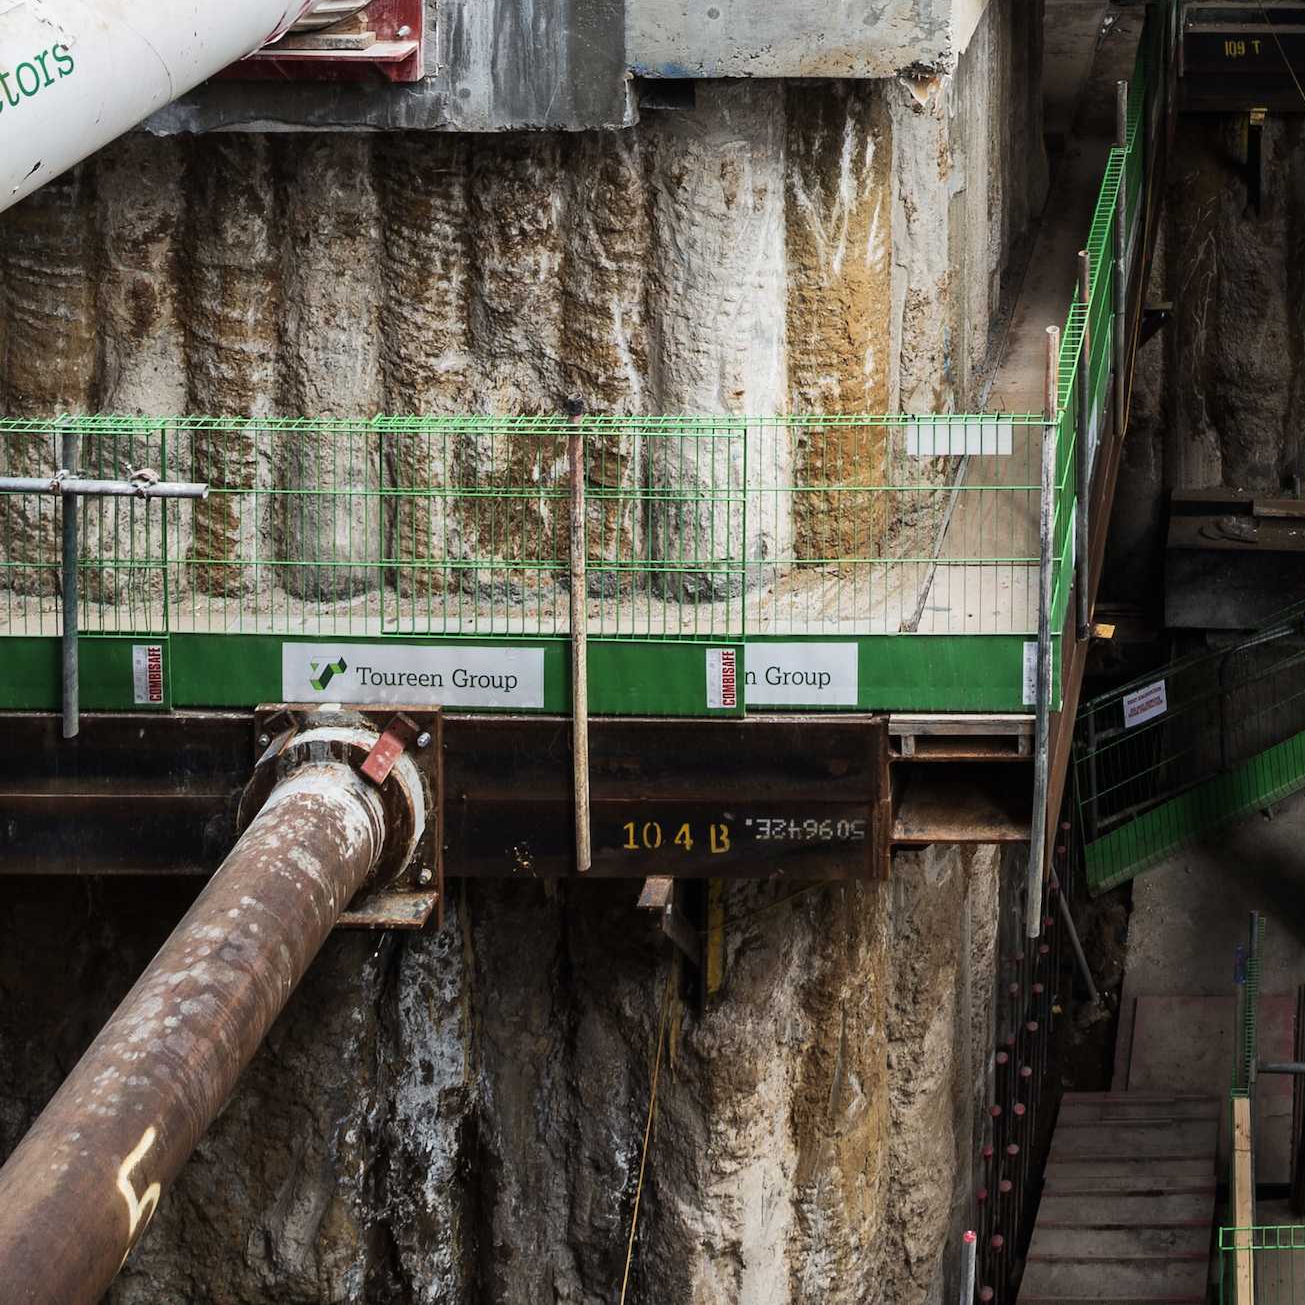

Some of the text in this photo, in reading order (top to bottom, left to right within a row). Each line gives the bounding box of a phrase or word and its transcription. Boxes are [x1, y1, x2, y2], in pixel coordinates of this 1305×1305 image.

[147, 647, 162, 701] COMBISAFE
[356, 667, 518, 692] Toureen Group
[722, 650, 736, 706] COMBISAFE
[765, 666, 832, 690] Group
